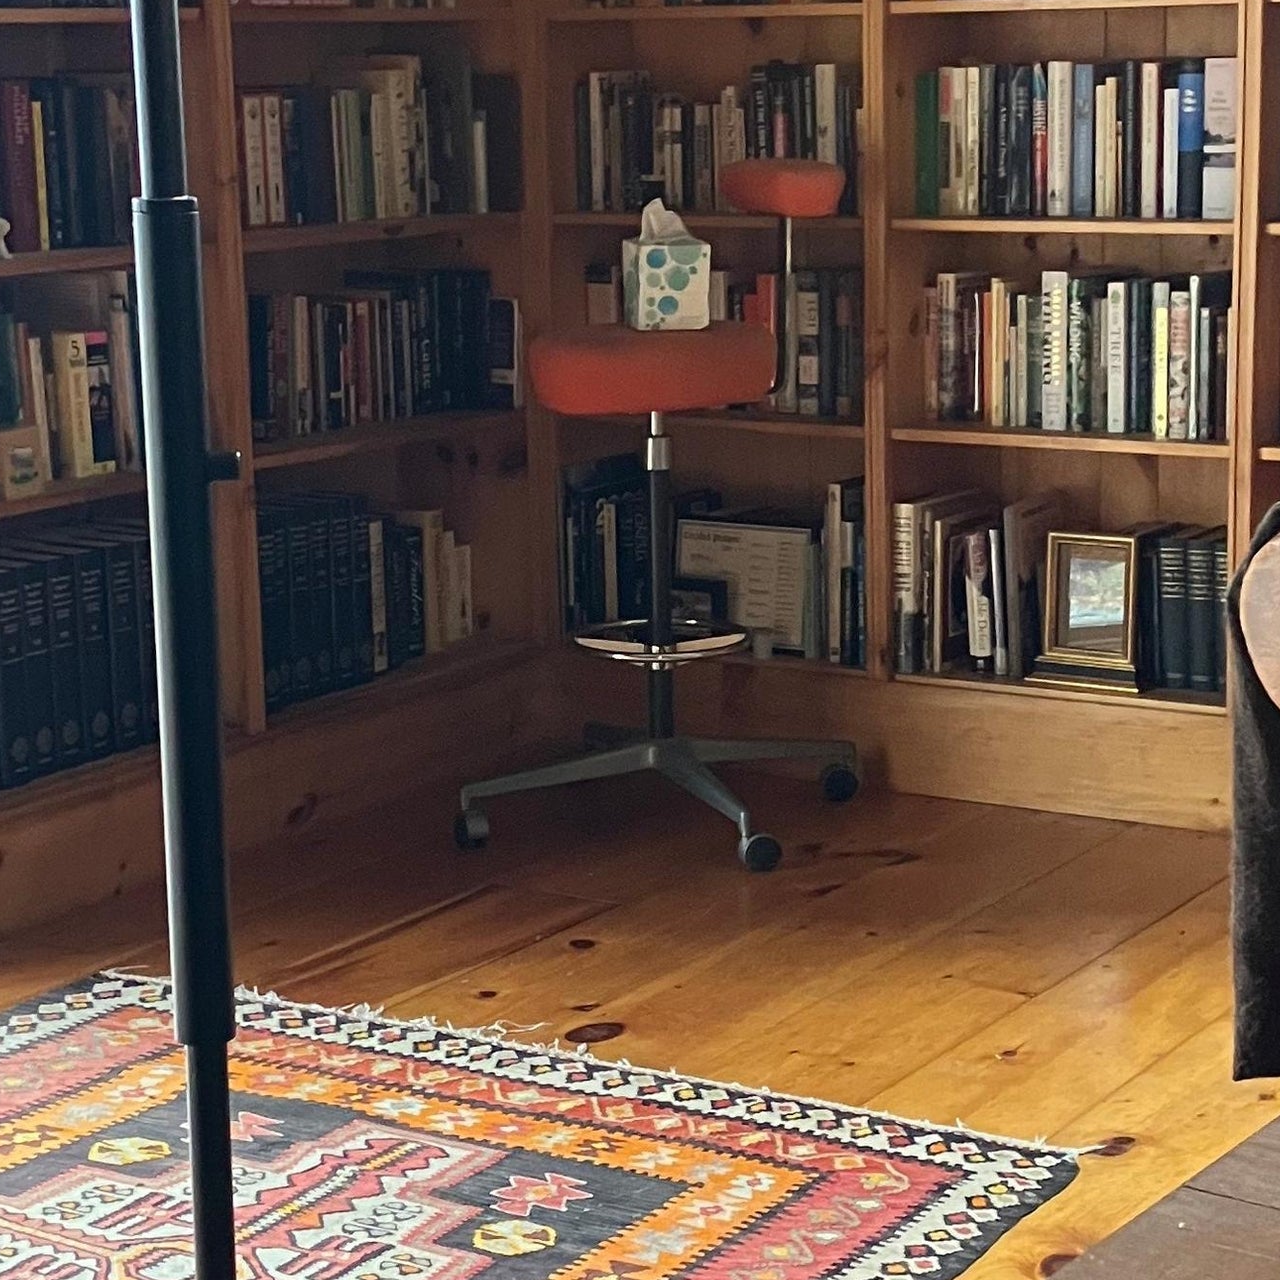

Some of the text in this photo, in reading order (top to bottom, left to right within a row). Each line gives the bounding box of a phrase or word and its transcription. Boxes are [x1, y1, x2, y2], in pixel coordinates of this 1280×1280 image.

[1033, 98, 1047, 136] JUSTICE
[71, 340, 80, 358] 5
[1069, 301, 1082, 364] WILDING
